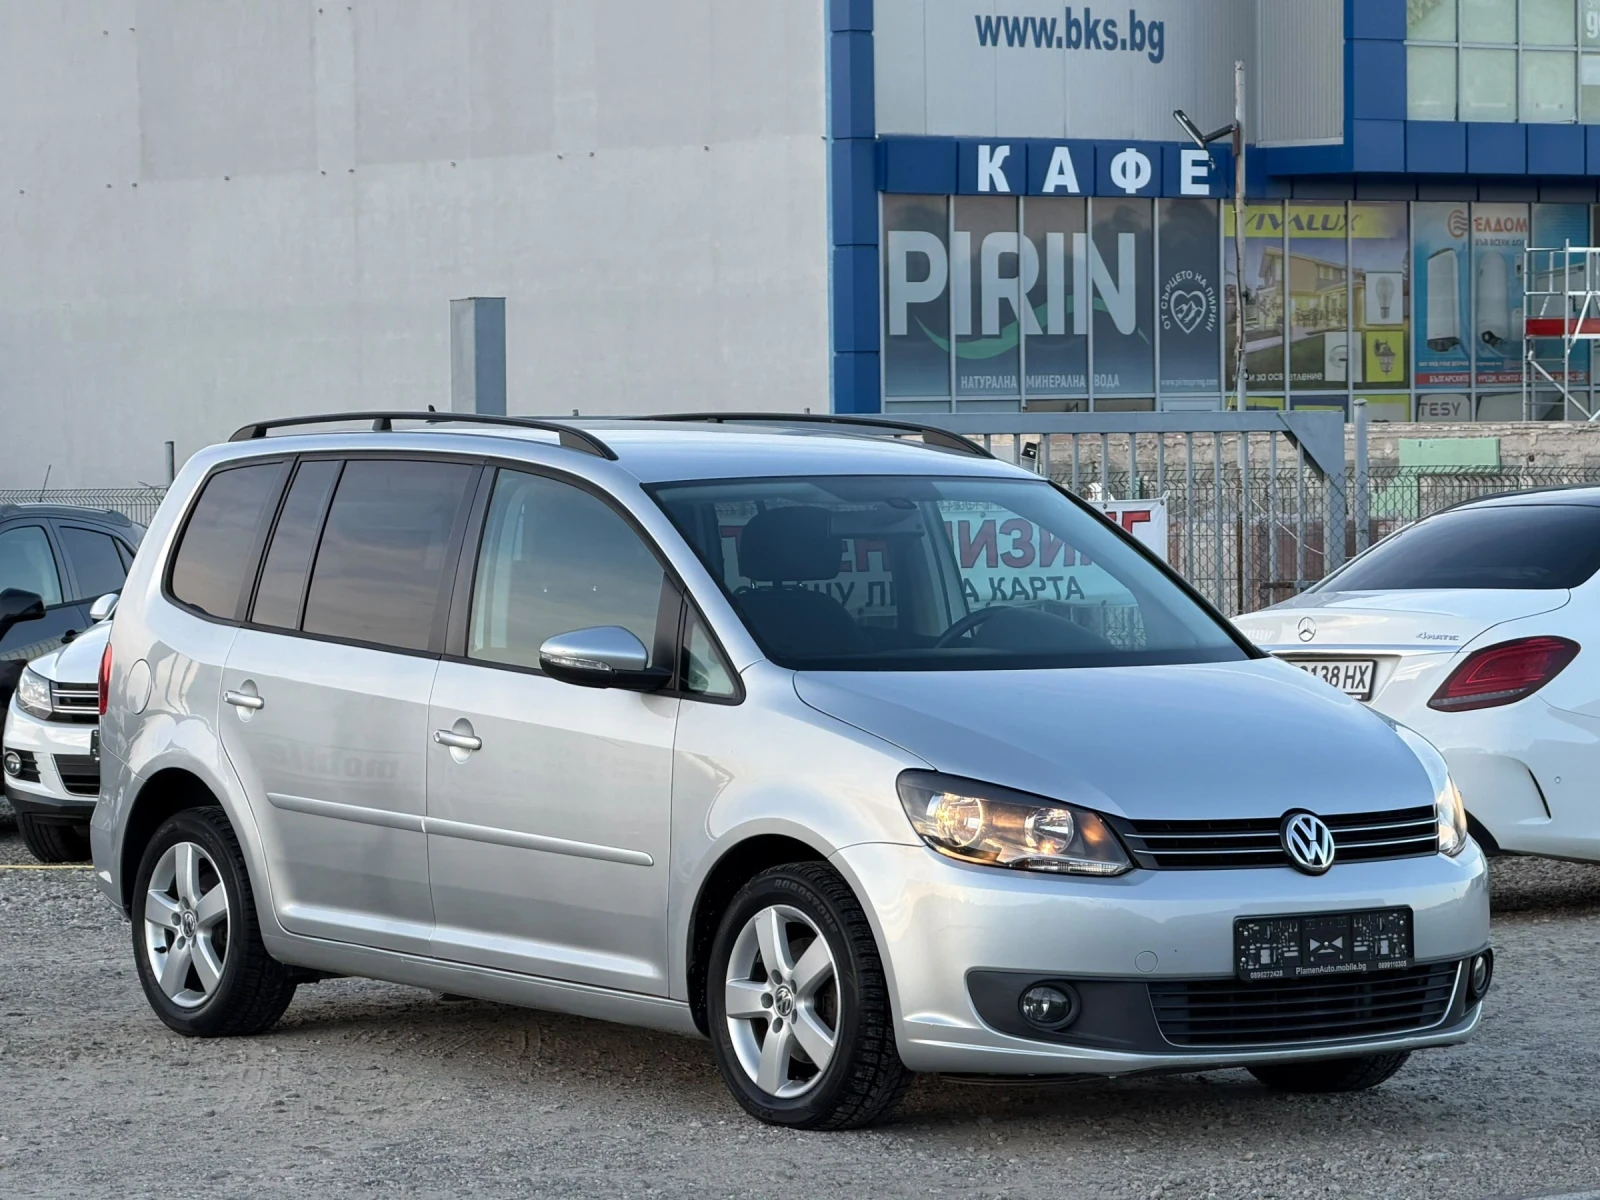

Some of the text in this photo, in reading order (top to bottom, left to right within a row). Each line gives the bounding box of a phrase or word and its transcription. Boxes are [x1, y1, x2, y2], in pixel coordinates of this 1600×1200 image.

[974, 6, 1165, 64] www.bks.bg
[976, 144, 1211, 196] КАФЕ
[887, 230, 1136, 336] PIRIN
[1160, 270, 1217, 332] ОТ СЪРЦЕТО НА ПИРИН
[960, 373, 1121, 389] НАТУРАЛНА МИНЕРАЛНА ВОДА
[1419, 402, 1461, 417] TESY
[988, 576, 1085, 601] КАРТА
[1415, 631, 1460, 641] 4MATIC
[1342, 665, 1370, 689] HX
[774, 879, 838, 933] ROADSTONE
[1295, 961, 1367, 976] PlamenAuto.mobile.bg
